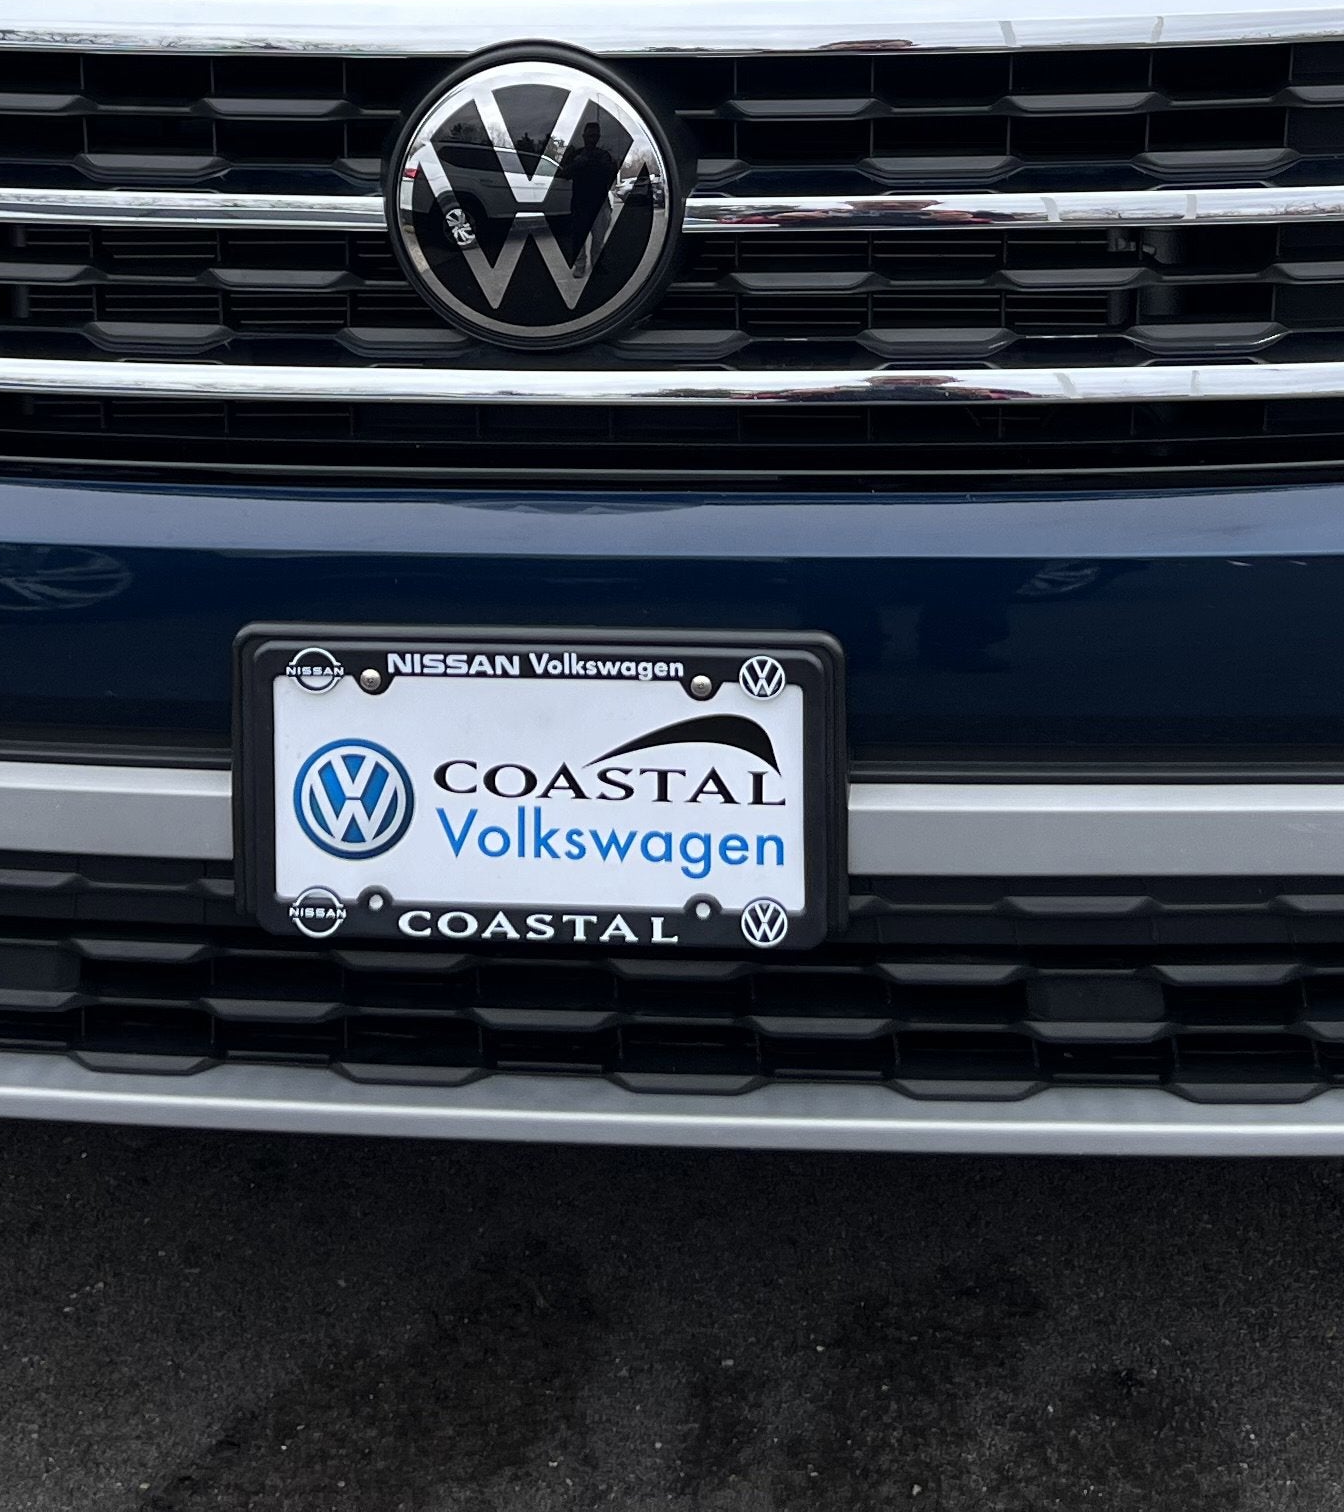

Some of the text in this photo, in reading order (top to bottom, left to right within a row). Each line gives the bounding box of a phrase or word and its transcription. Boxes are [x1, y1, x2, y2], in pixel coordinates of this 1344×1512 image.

[285, 665, 345, 678] NISSAN
[386, 652, 685, 681] NISSAN Volkswagen
[432, 759, 787, 806] COASTAL
[435, 805, 785, 879] Volkswagen
[288, 906, 347, 920] NISSAN
[397, 909, 679, 944] COASTAL
